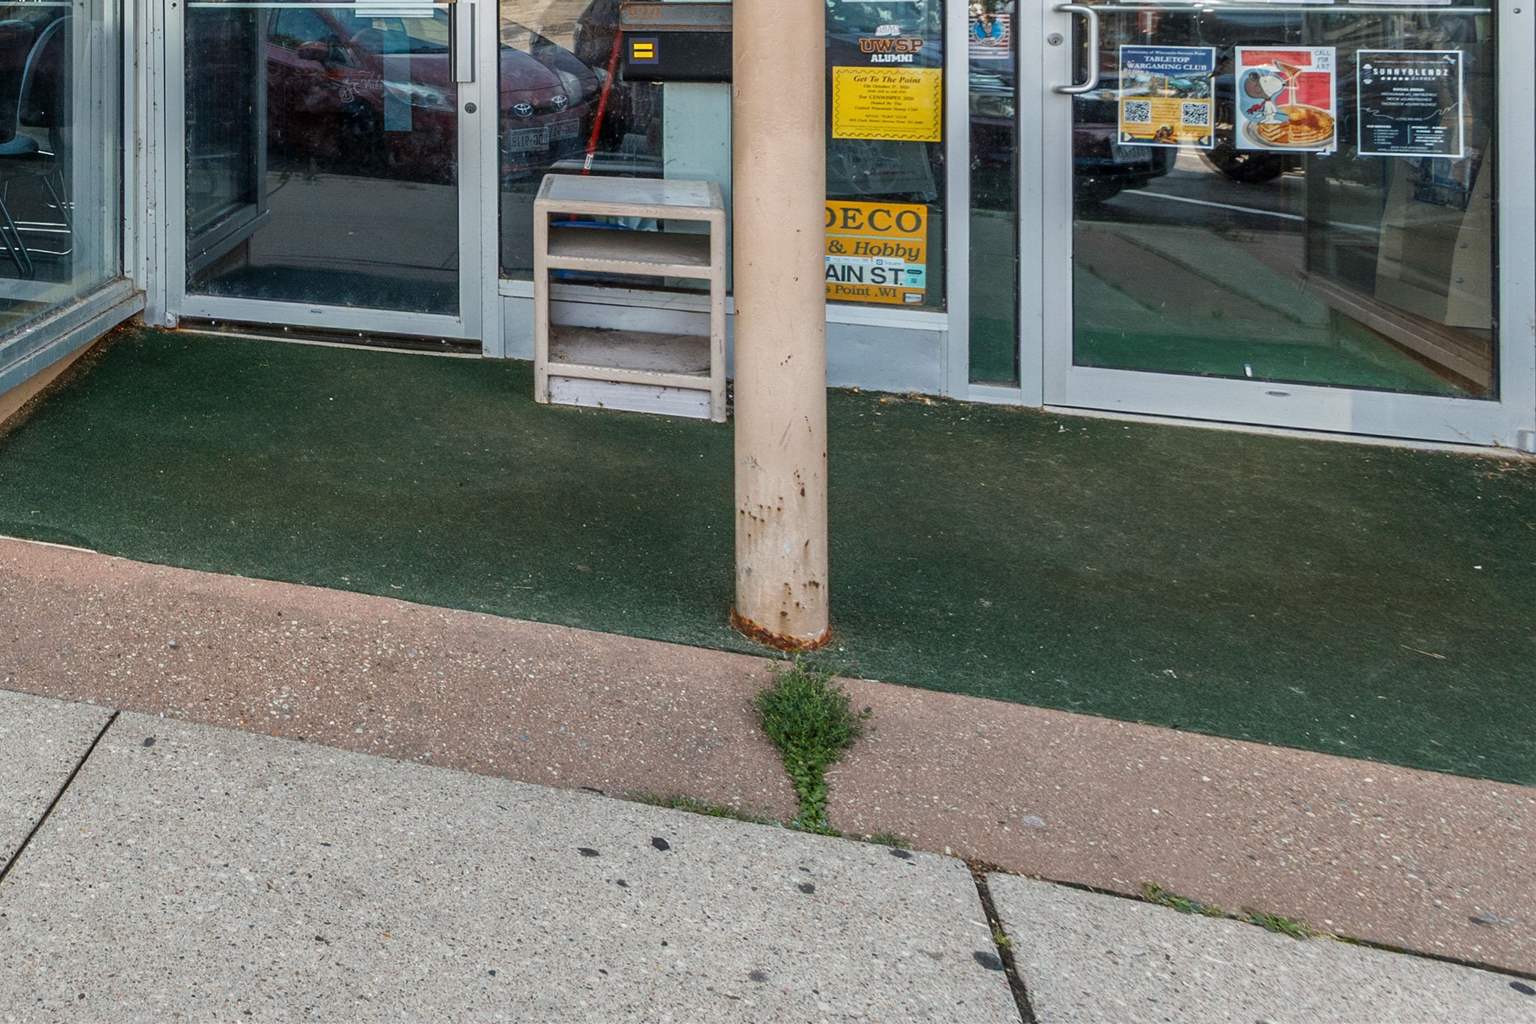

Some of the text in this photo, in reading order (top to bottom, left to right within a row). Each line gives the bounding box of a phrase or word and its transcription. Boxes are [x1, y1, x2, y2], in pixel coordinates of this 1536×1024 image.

[858, 37, 924, 53] UWSP
[870, 54, 913, 62] ALUMNI
[1127, 62, 1182, 71] WARGAMING
[828, 240, 920, 262] & Hobby
[871, 267, 904, 286] ST.
[835, 285, 870, 296] Point
